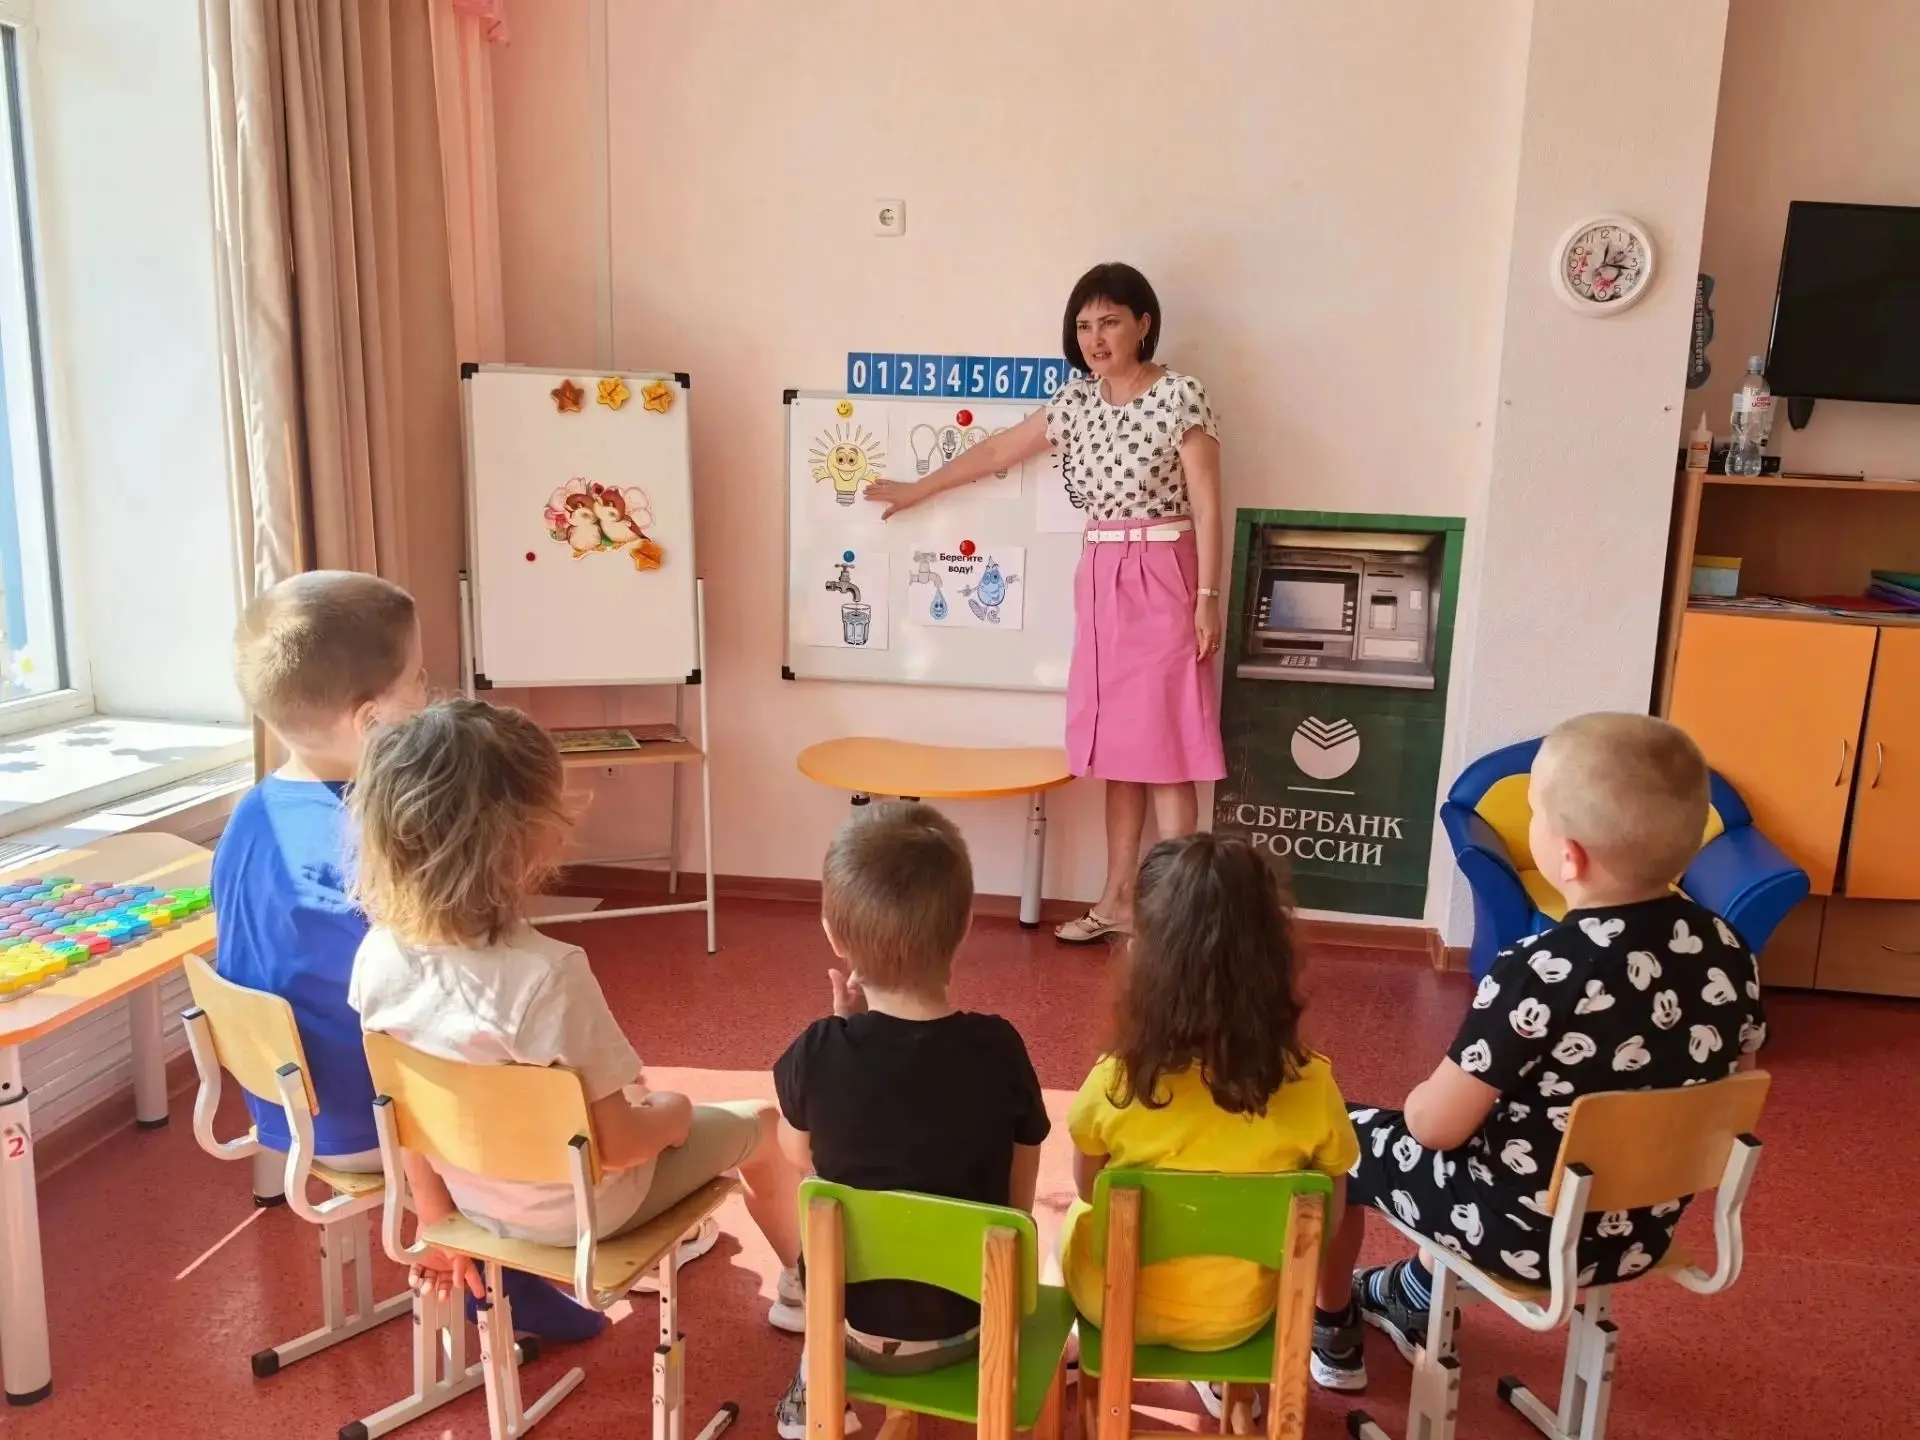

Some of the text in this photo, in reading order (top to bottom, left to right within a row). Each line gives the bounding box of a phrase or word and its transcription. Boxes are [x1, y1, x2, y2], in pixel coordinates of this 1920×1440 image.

[1585, 233, 1594, 244] 11
[1600, 229, 1610, 239] 12
[1627, 242, 1635, 253] 2
[1569, 259, 1579, 272] 9
[1630, 257, 1638, 268] 3
[1572, 274, 1582, 286] 8
[1624, 272, 1633, 282] 4
[1583, 282, 1591, 295] 7
[1598, 287, 1607, 299] 6
[1613, 284, 1622, 294] 5
[939, 553, 983, 563] Берегите
[948, 565, 973, 574] воду!
[1236, 803, 1404, 840] СБЕРБАНК
[1251, 832, 1384, 867] РОССИИ
[8, 1136, 25, 1158] 2
